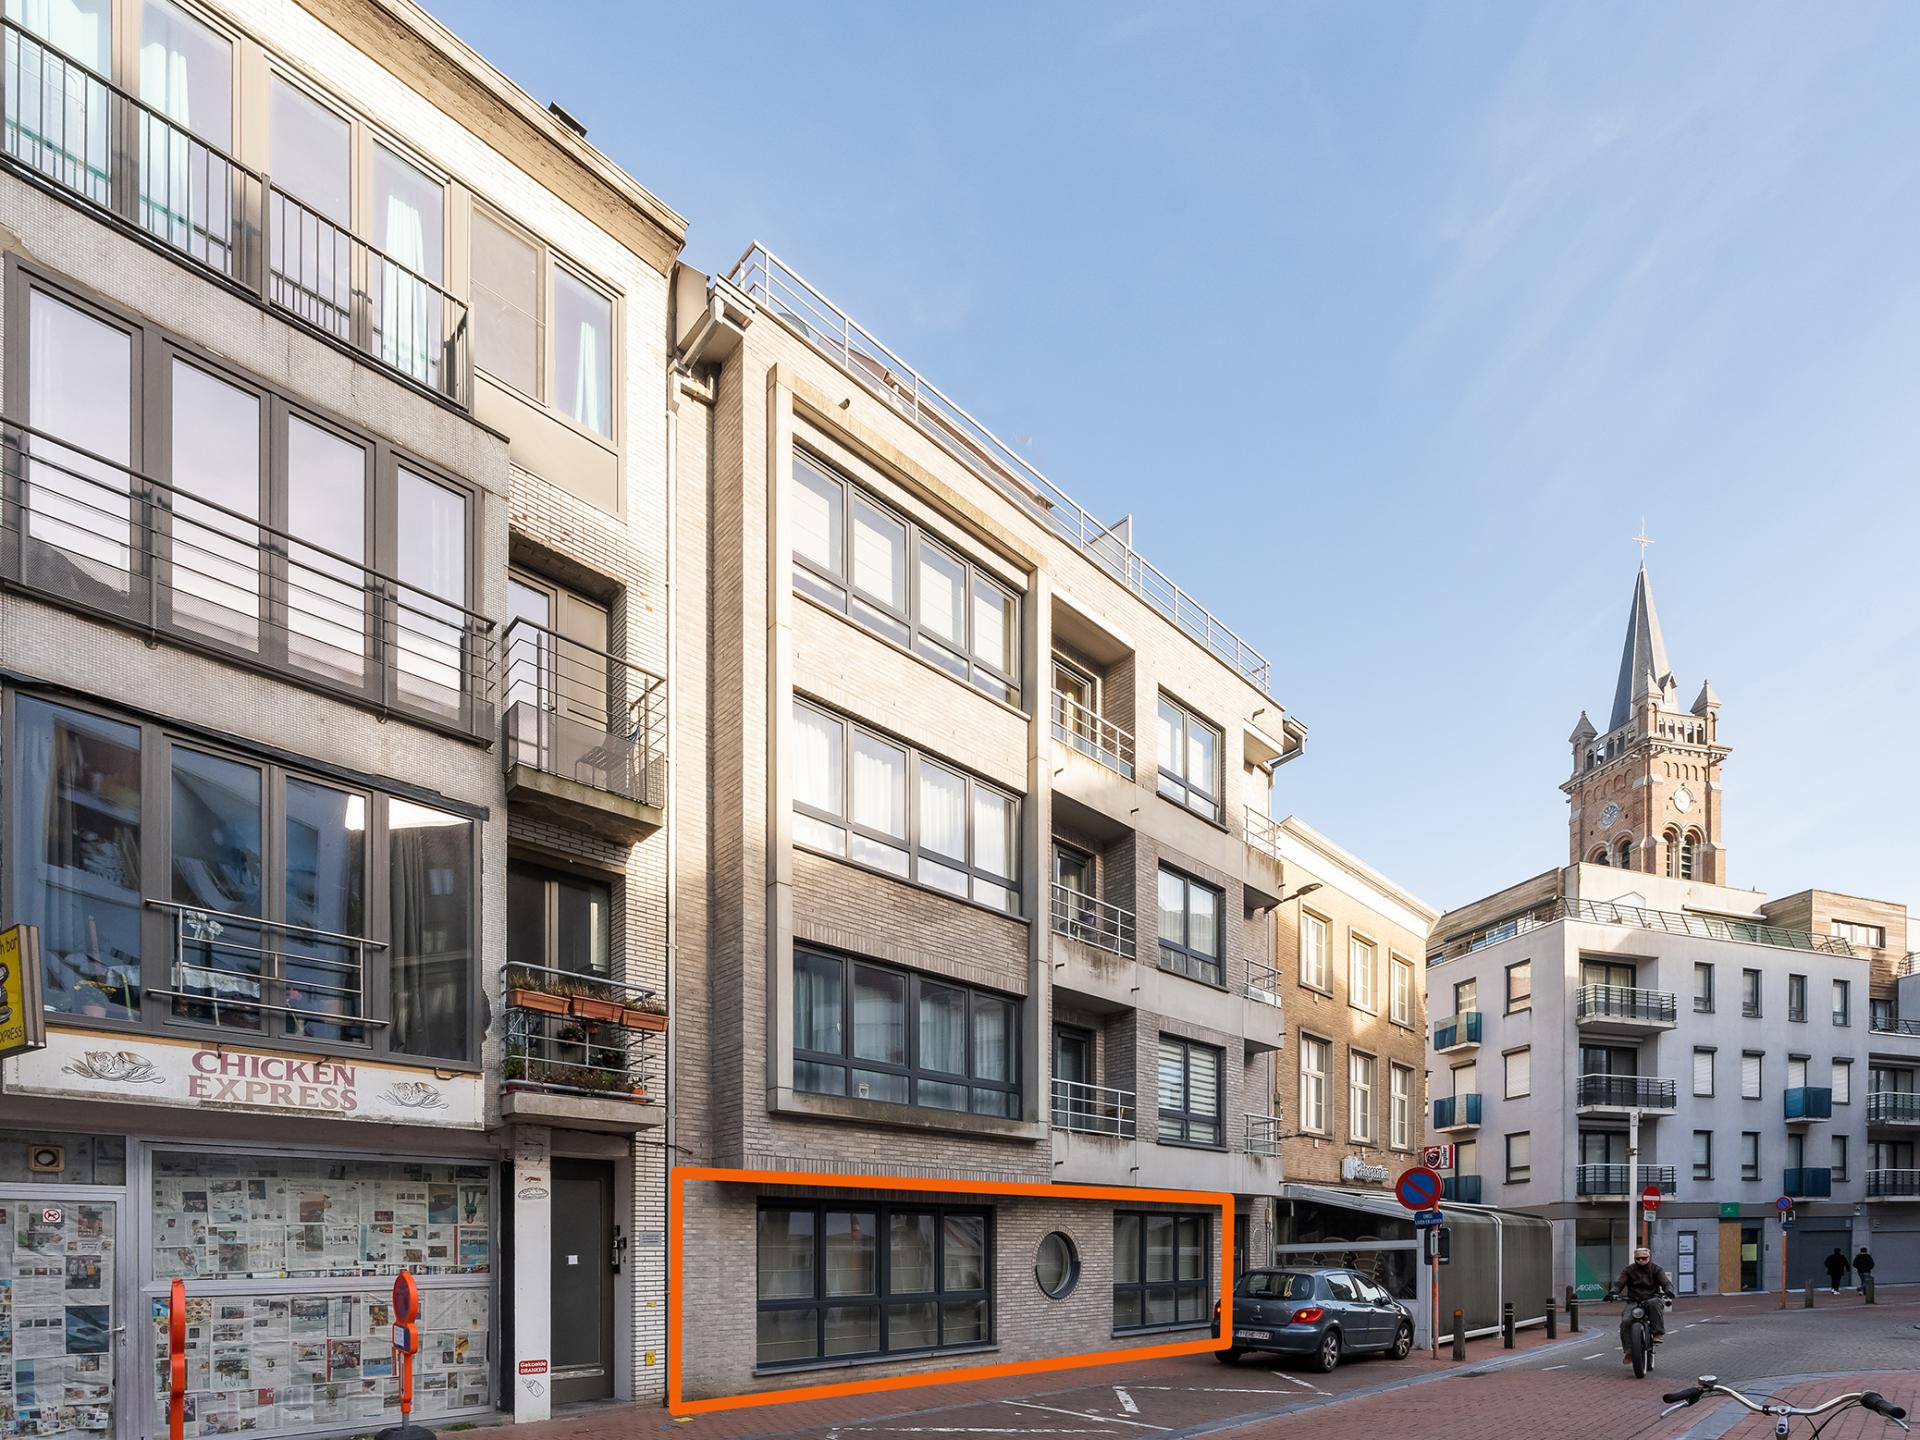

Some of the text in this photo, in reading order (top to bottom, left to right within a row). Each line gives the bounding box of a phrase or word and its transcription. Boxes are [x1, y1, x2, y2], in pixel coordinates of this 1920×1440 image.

[6, 936, 17, 953] bar
[192, 1051, 357, 1088] CHICKEN
[188, 1074, 358, 1111] EXPRESS
